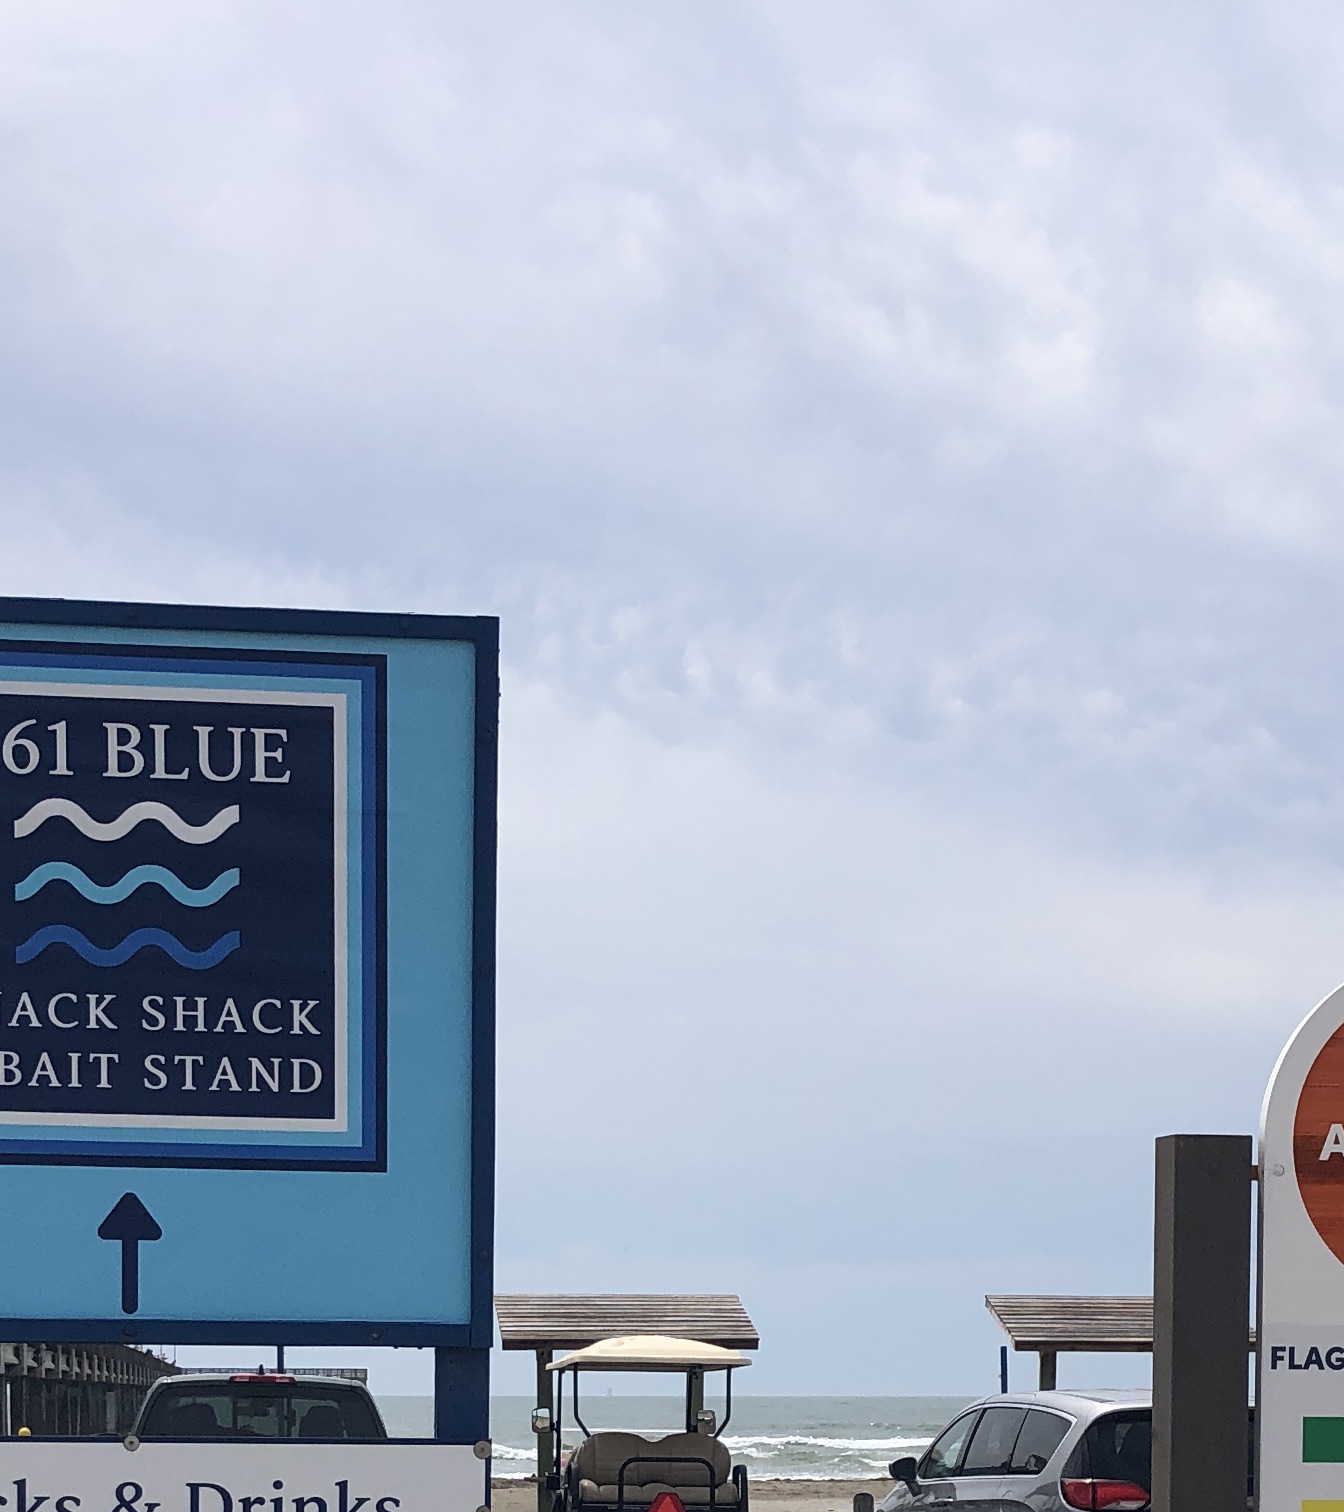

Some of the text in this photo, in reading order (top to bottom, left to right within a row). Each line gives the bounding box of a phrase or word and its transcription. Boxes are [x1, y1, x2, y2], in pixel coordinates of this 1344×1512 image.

[102, 722, 293, 783] BLUE
[141, 995, 321, 1035] SHACK
[143, 1054, 323, 1093] STAND
